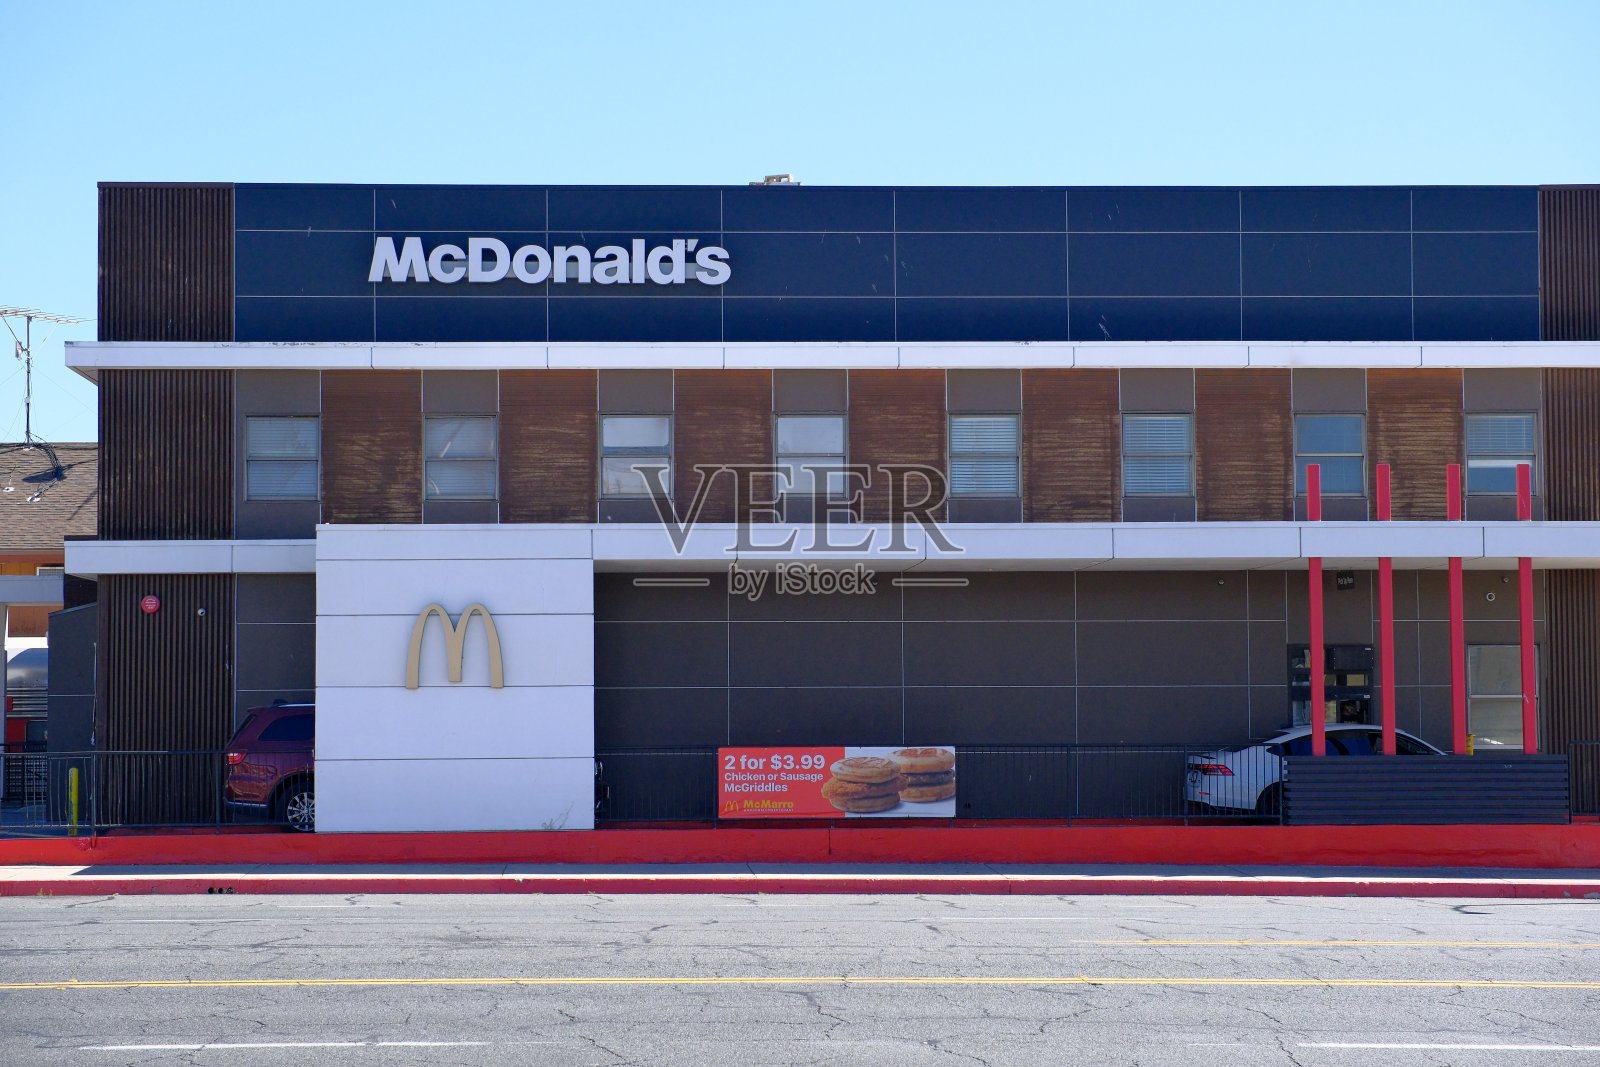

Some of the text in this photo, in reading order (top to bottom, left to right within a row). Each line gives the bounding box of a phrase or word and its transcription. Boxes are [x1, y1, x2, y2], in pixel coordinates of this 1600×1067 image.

[368, 236, 731, 285] McDonald's
[724, 753, 826, 771] 2 for $3.99
[724, 772, 824, 783] Chicken or Sausage
[724, 782, 788, 793] McGriddles
